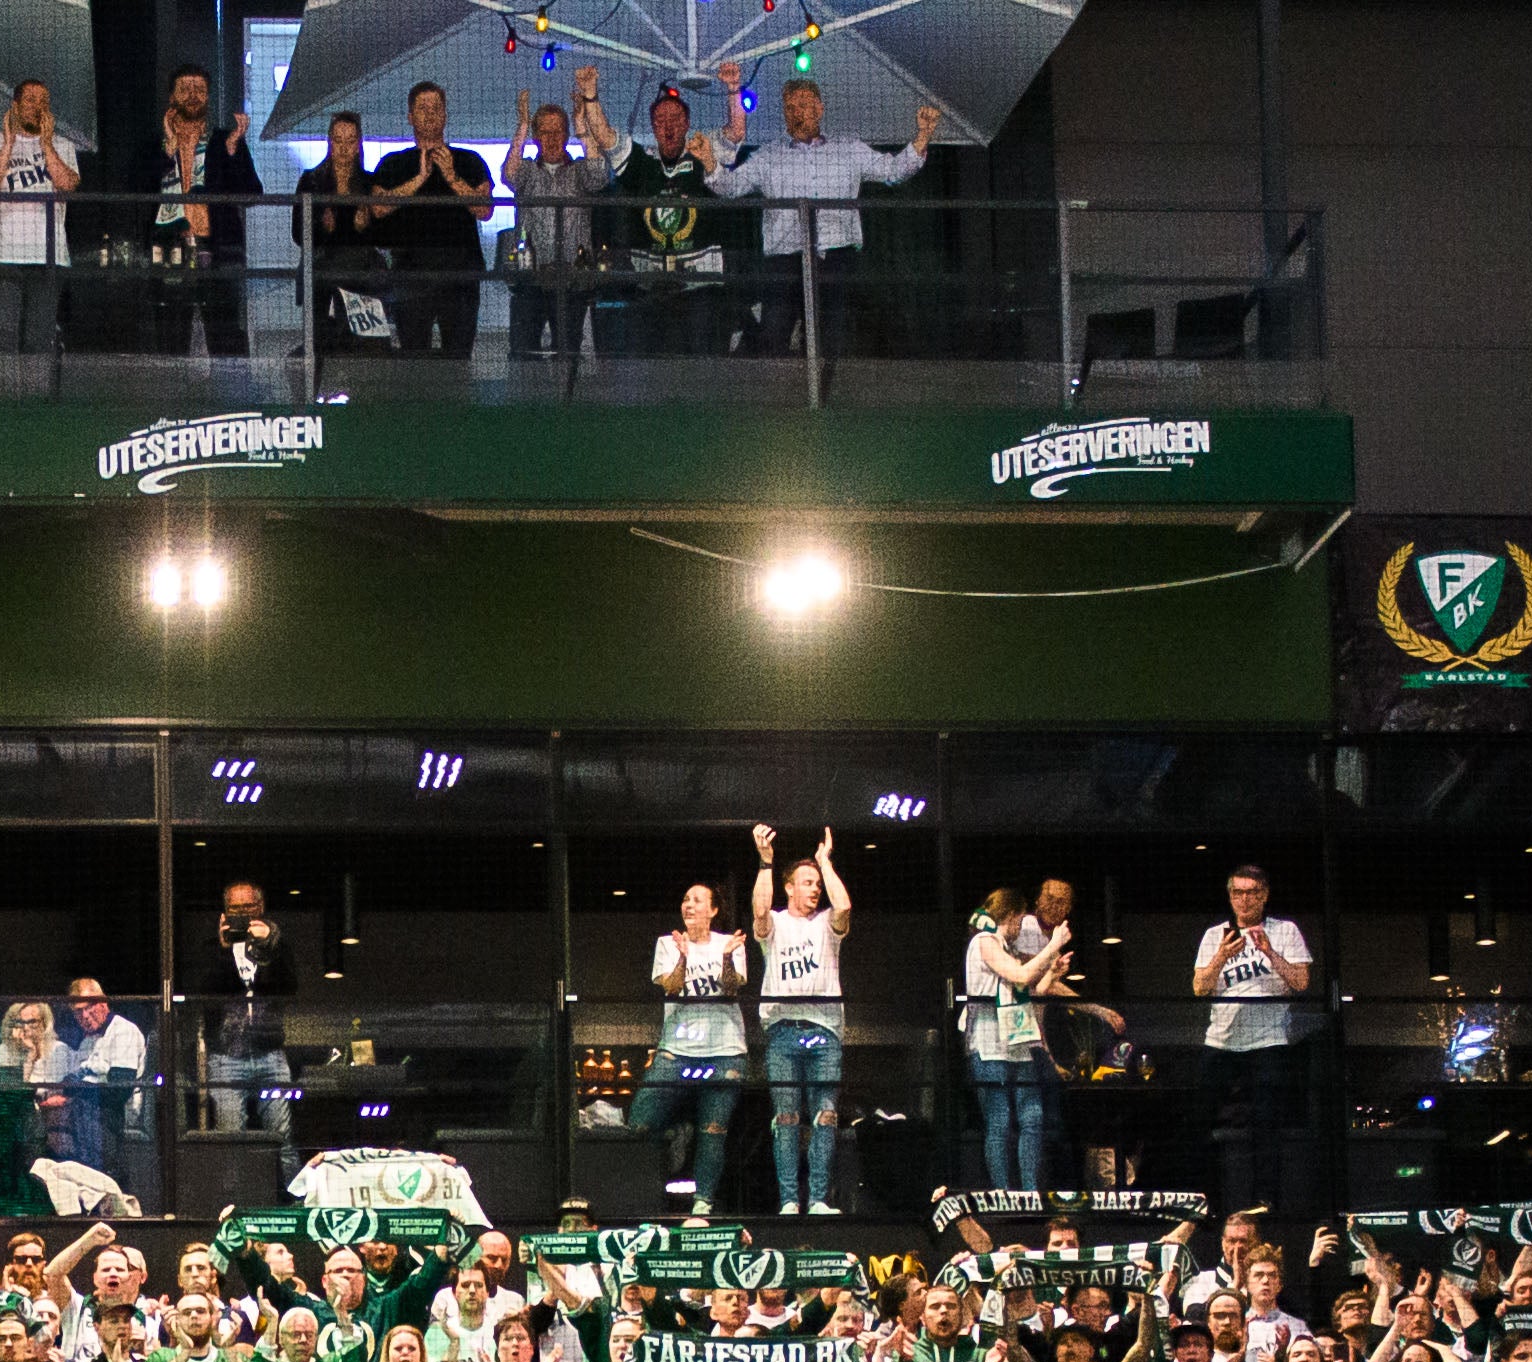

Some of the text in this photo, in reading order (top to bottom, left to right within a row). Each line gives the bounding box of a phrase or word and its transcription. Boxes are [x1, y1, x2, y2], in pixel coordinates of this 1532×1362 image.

[98, 416, 322, 479] UTESERVERINGEN
[991, 421, 1210, 484] UTESERVERINGEN
[1425, 671, 1507, 681] KARLSTAD
[781, 954, 819, 981] FBK
[1223, 959, 1272, 987] FBK
[936, 1196, 973, 1233] STORT
